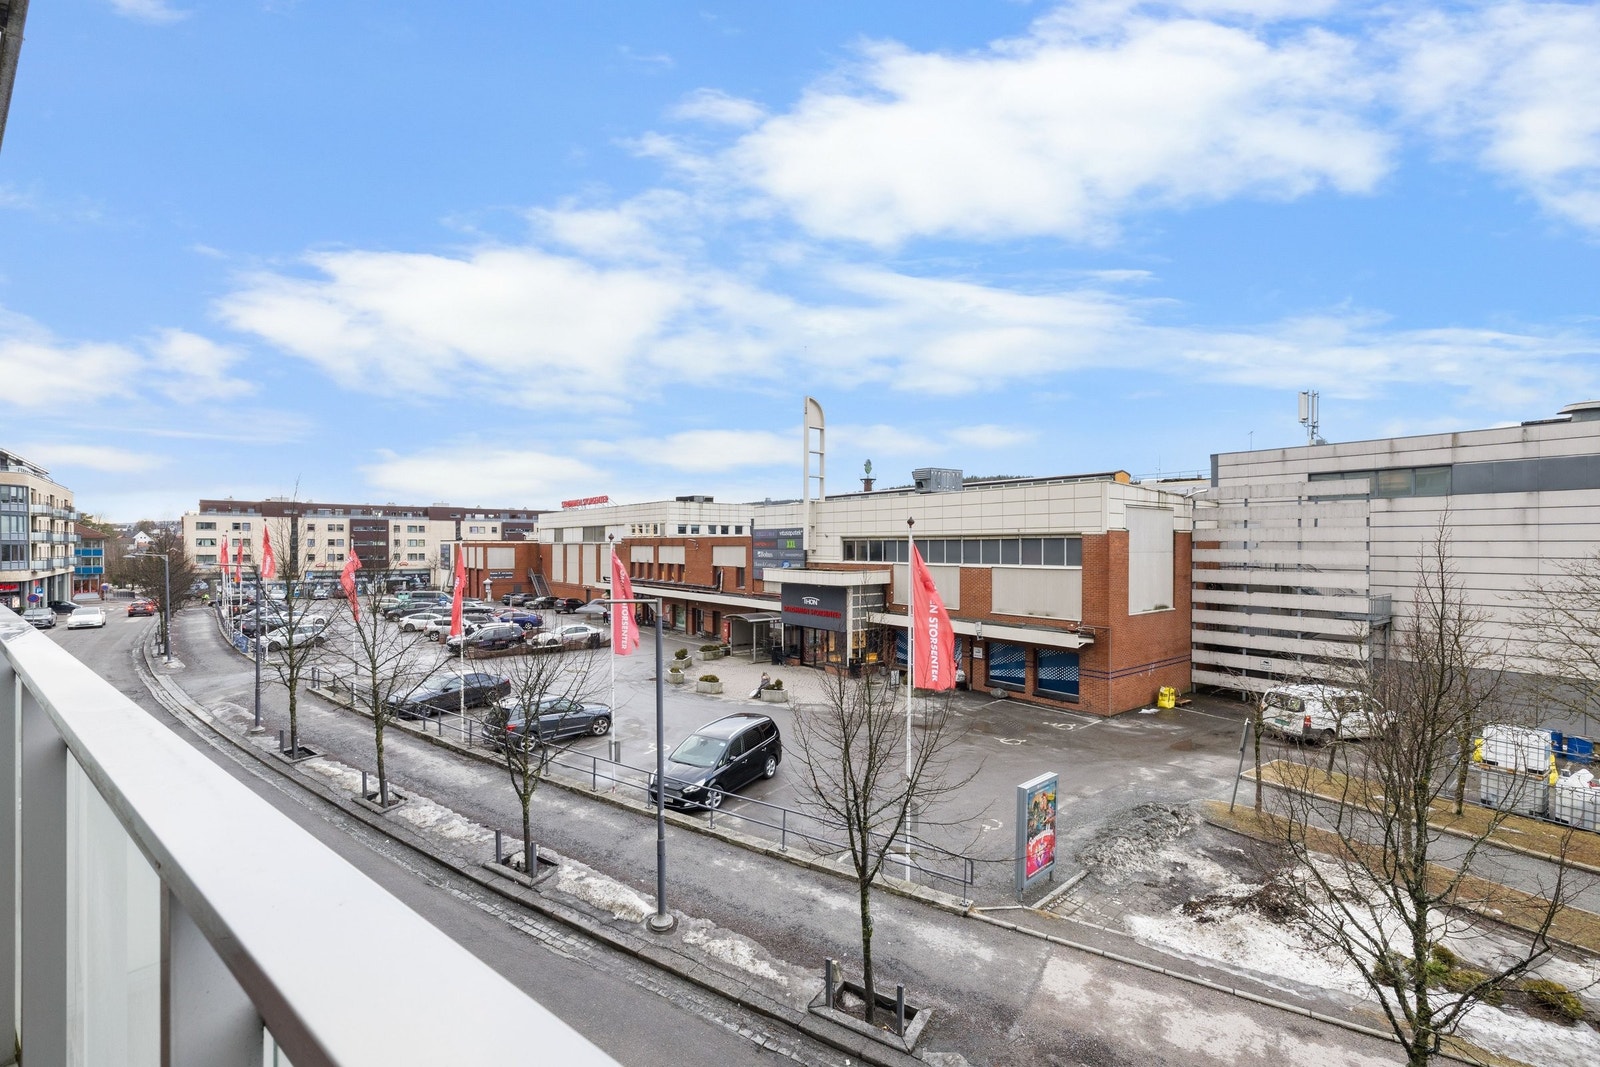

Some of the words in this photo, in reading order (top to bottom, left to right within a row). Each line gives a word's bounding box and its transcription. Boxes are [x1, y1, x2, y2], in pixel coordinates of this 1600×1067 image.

[786, 539, 796, 549] XXL
[802, 596, 820, 606] THON
[928, 616, 939, 682] STORSENTER
